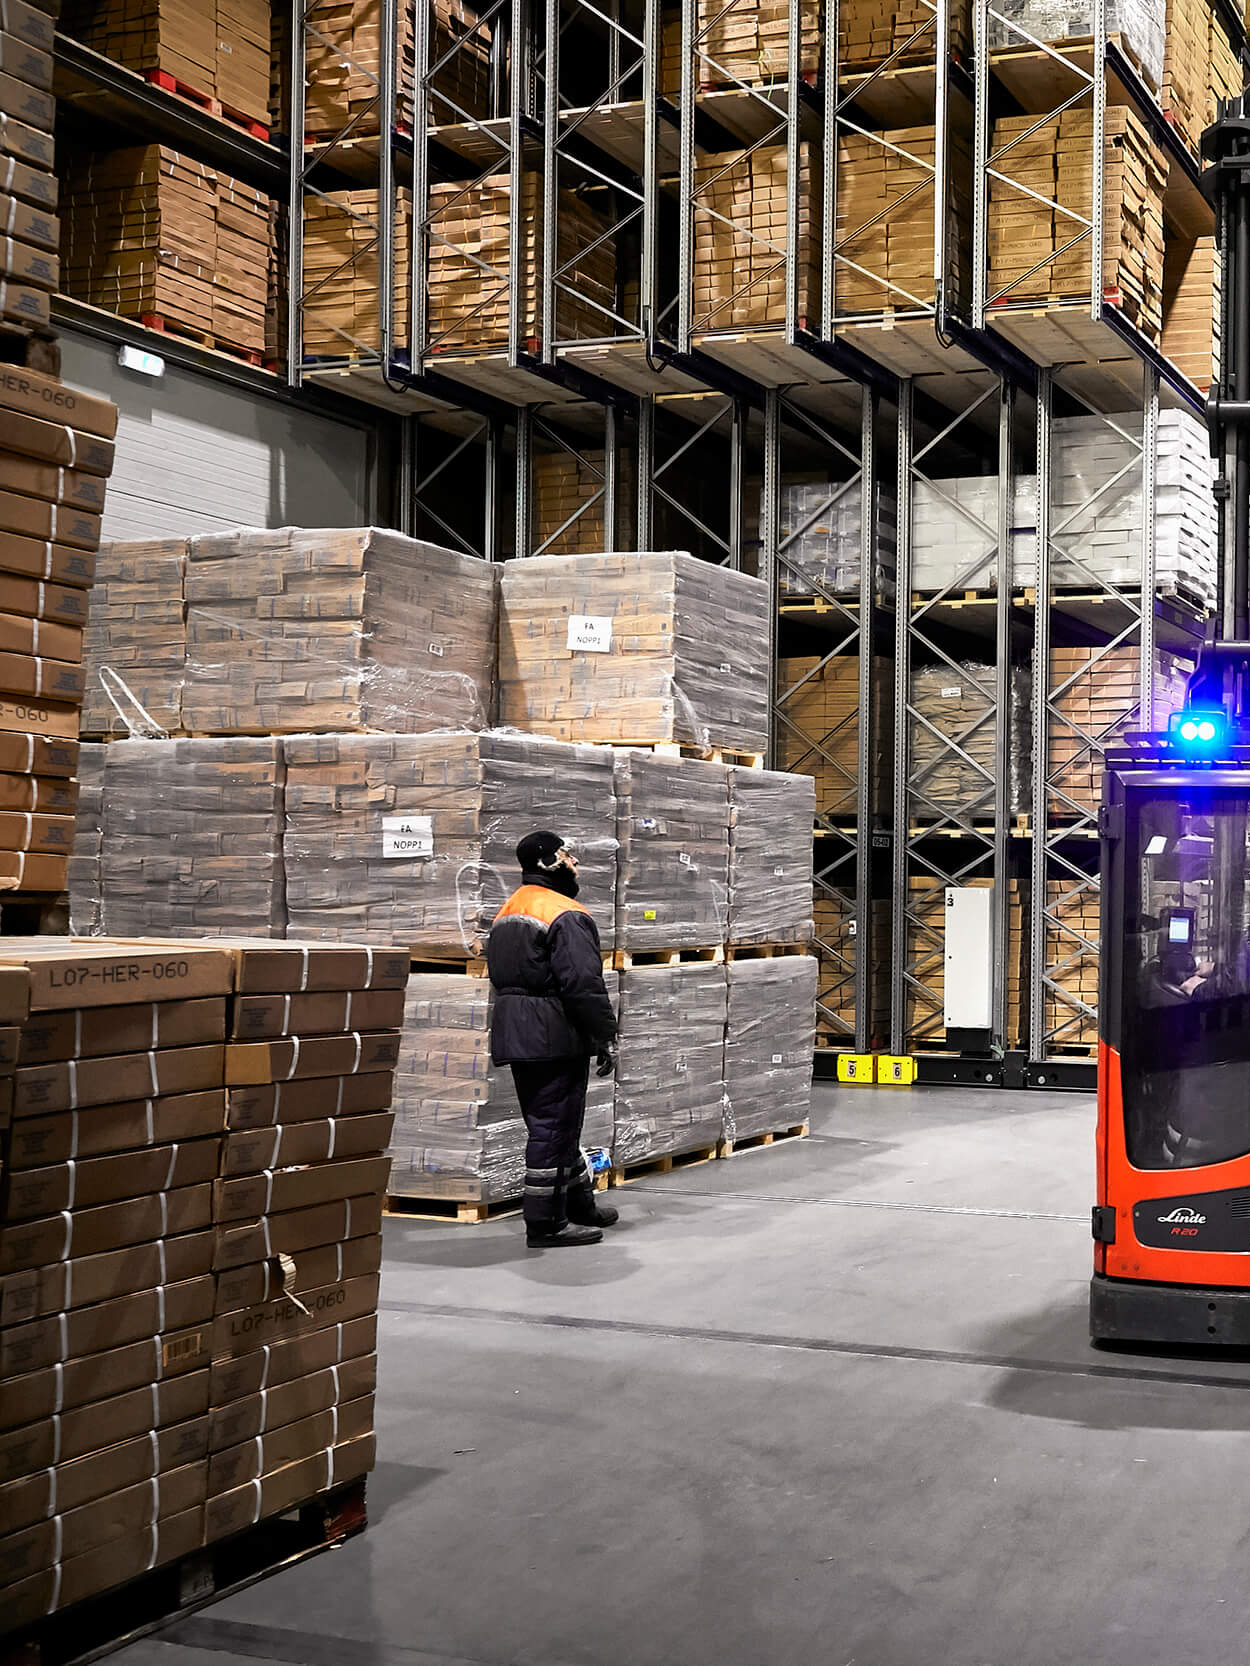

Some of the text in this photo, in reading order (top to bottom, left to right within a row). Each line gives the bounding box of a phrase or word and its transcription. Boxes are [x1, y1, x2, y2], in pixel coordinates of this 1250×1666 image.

[947, 897, 954, 907] 3
[50, 961, 189, 988] L07-HER-060
[848, 1065, 855, 1075] 5
[894, 1066, 901, 1077] 6
[1157, 1207, 1207, 1224] Linde
